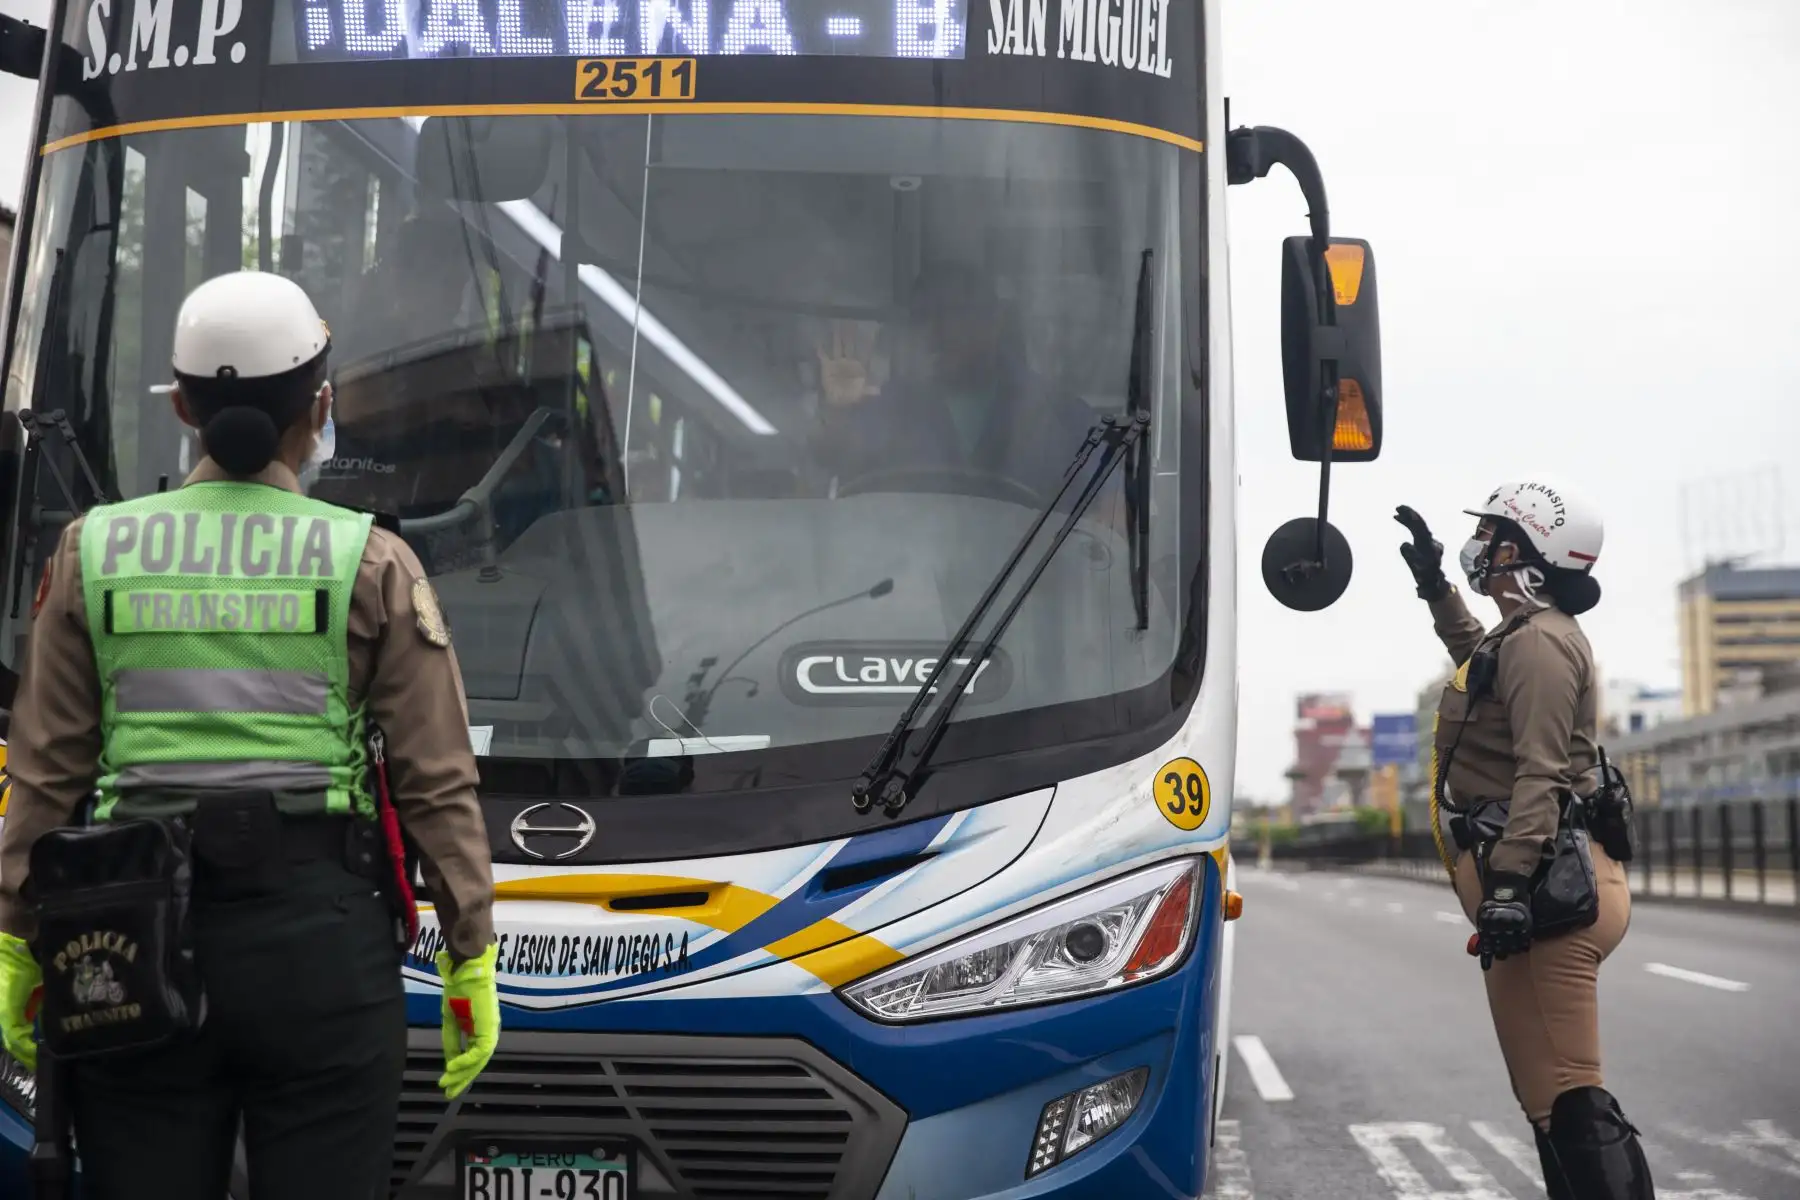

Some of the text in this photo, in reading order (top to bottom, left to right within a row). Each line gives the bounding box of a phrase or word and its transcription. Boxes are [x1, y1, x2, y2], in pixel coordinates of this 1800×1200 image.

[82, 0, 246, 81] S.M.P.
[988, 0, 1172, 78] SAN MIGUEL
[580, 60, 691, 98] 2511
[1519, 482, 1565, 527] TRANSITO
[101, 511, 334, 577] POLICIA
[128, 592, 300, 631] TRANSITO
[1164, 772, 1203, 816] 39
[53, 930, 138, 973] POLICIA
[507, 934, 556, 975] JESUS
[558, 935, 580, 976] DE
[581, 935, 613, 976] SAN
[614, 932, 660, 976] DIEGO
